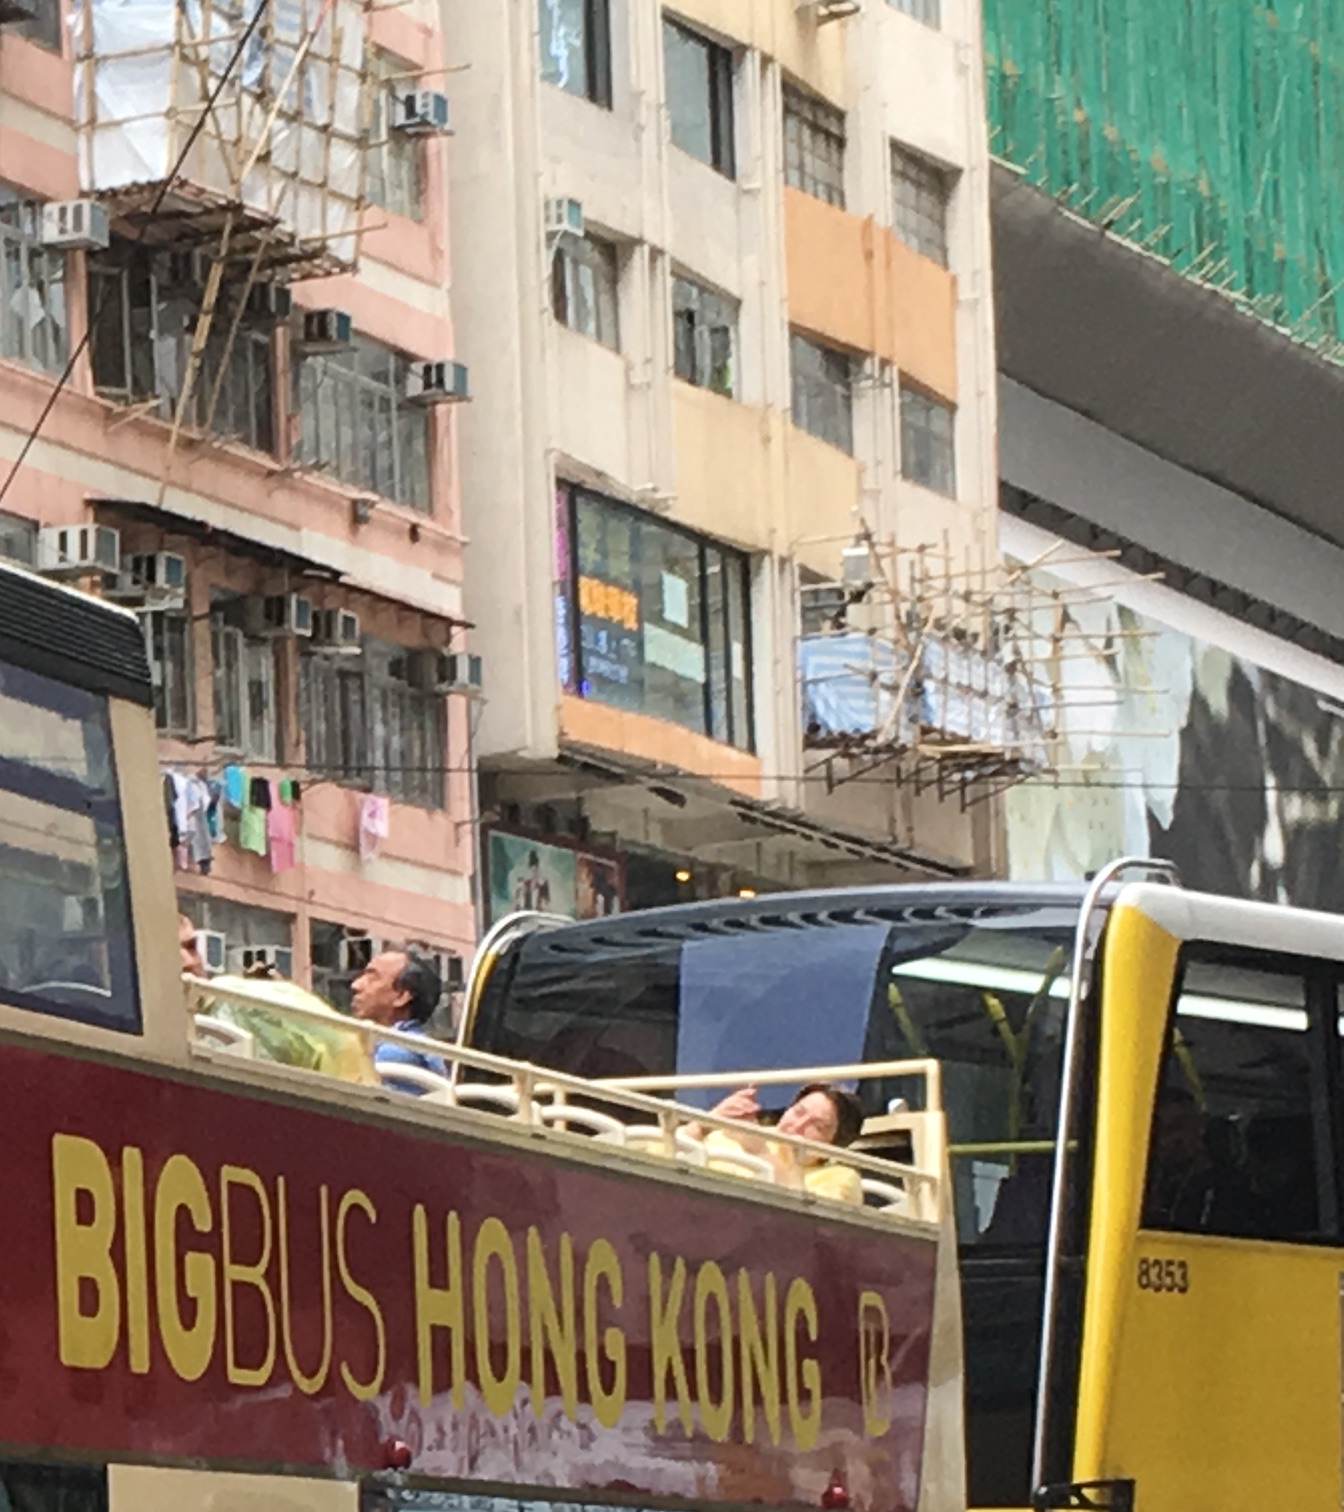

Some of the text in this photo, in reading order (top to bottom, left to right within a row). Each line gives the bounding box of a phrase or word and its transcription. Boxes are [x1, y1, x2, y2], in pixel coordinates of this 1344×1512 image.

[411, 1203, 627, 1430] HONG
[648, 1251, 823, 1453] KONG
[1137, 1257, 1189, 1295] 8353
